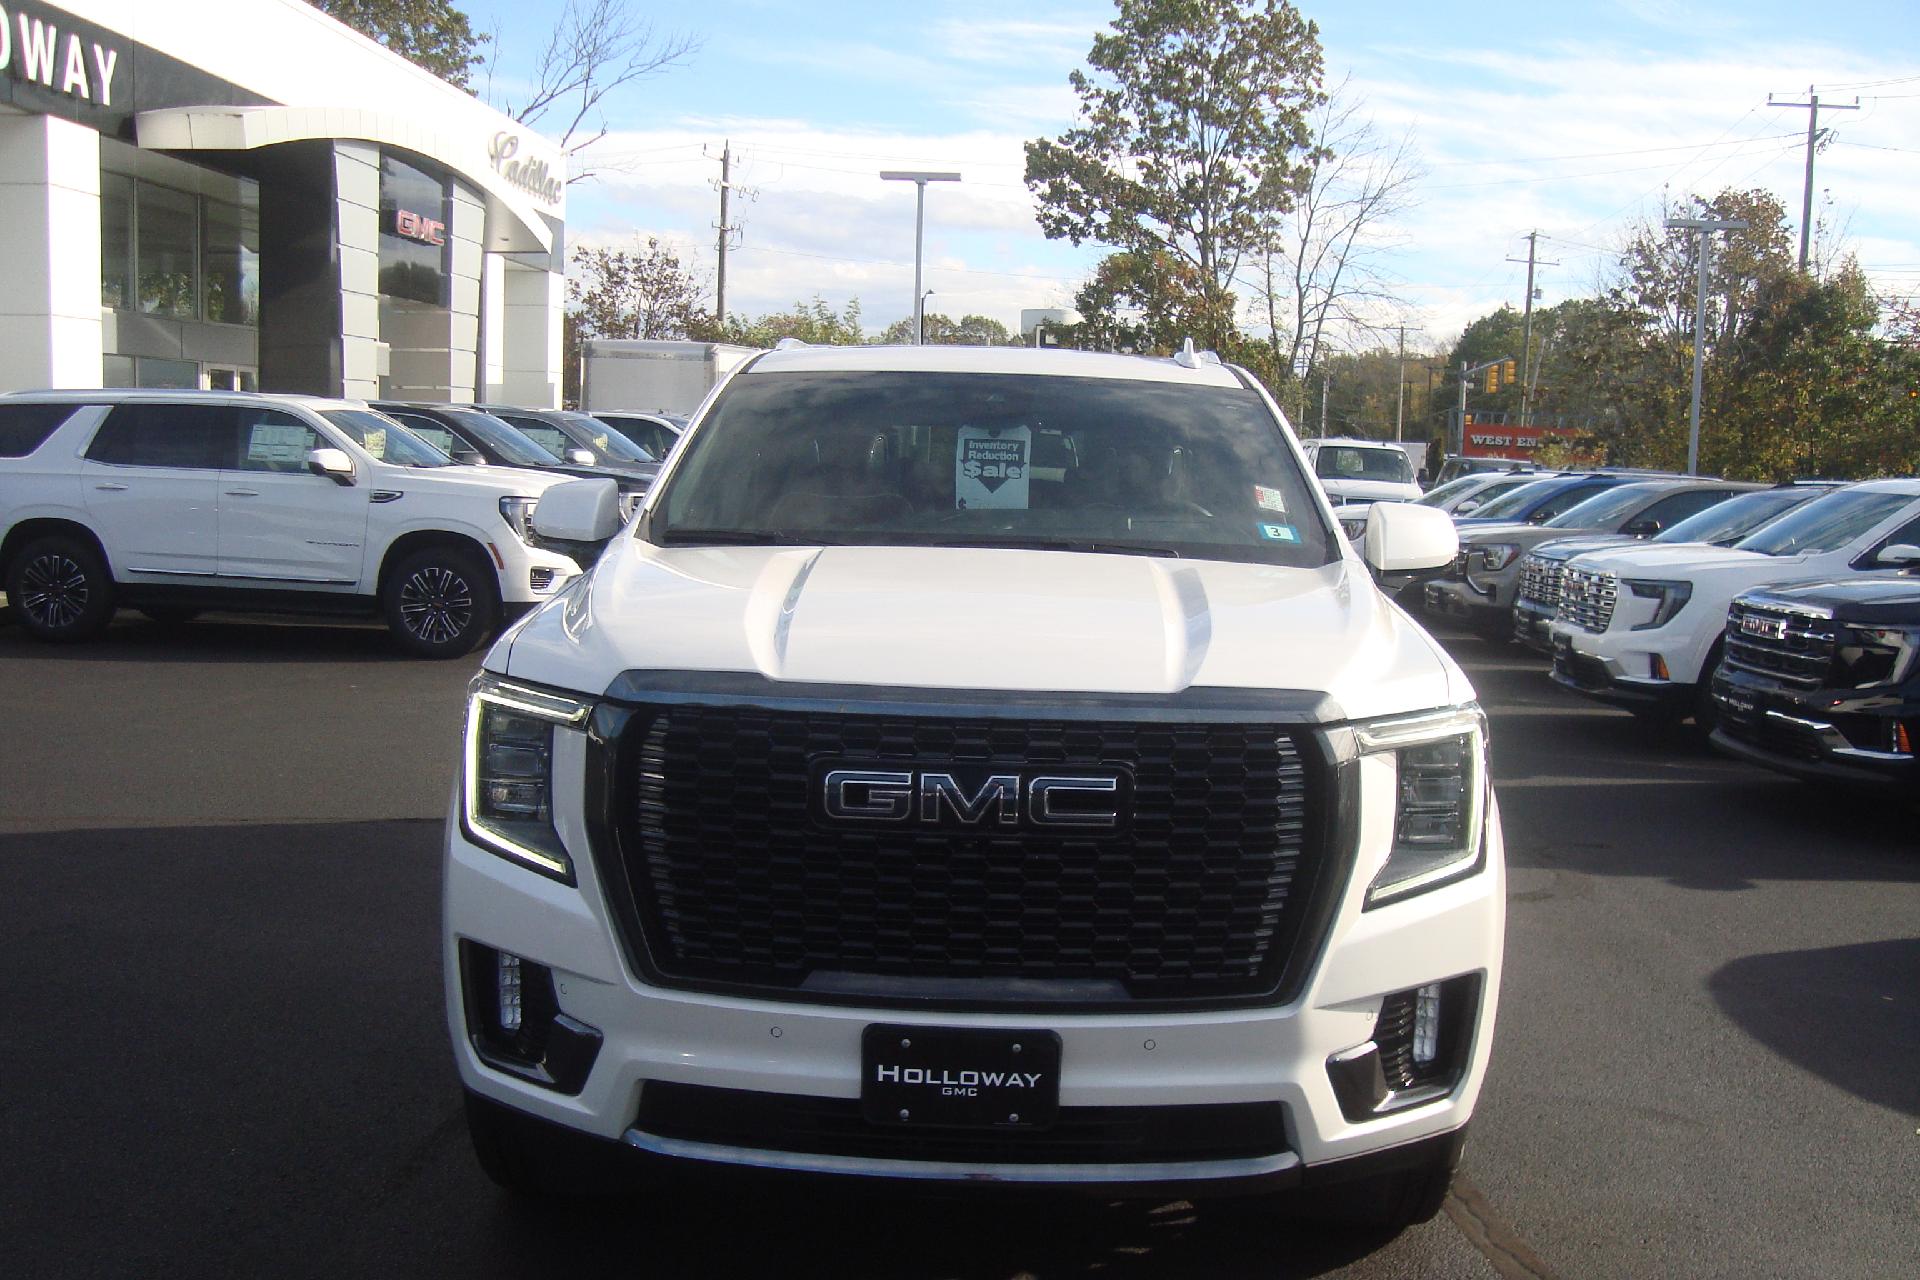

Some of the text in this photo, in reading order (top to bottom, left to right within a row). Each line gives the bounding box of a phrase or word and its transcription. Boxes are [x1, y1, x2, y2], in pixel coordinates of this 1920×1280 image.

[488, 131, 562, 205] Cadillac
[398, 209, 445, 246] GMC
[968, 440, 1020, 452] Inventory
[1471, 434, 1543, 448] WEST EN
[968, 451, 1019, 461] Reduction
[1271, 527, 1281, 537] 3
[824, 770, 1117, 826] GMC
[877, 1064, 1042, 1088] HOLLOWAY
[942, 1087, 978, 1097] GMC
